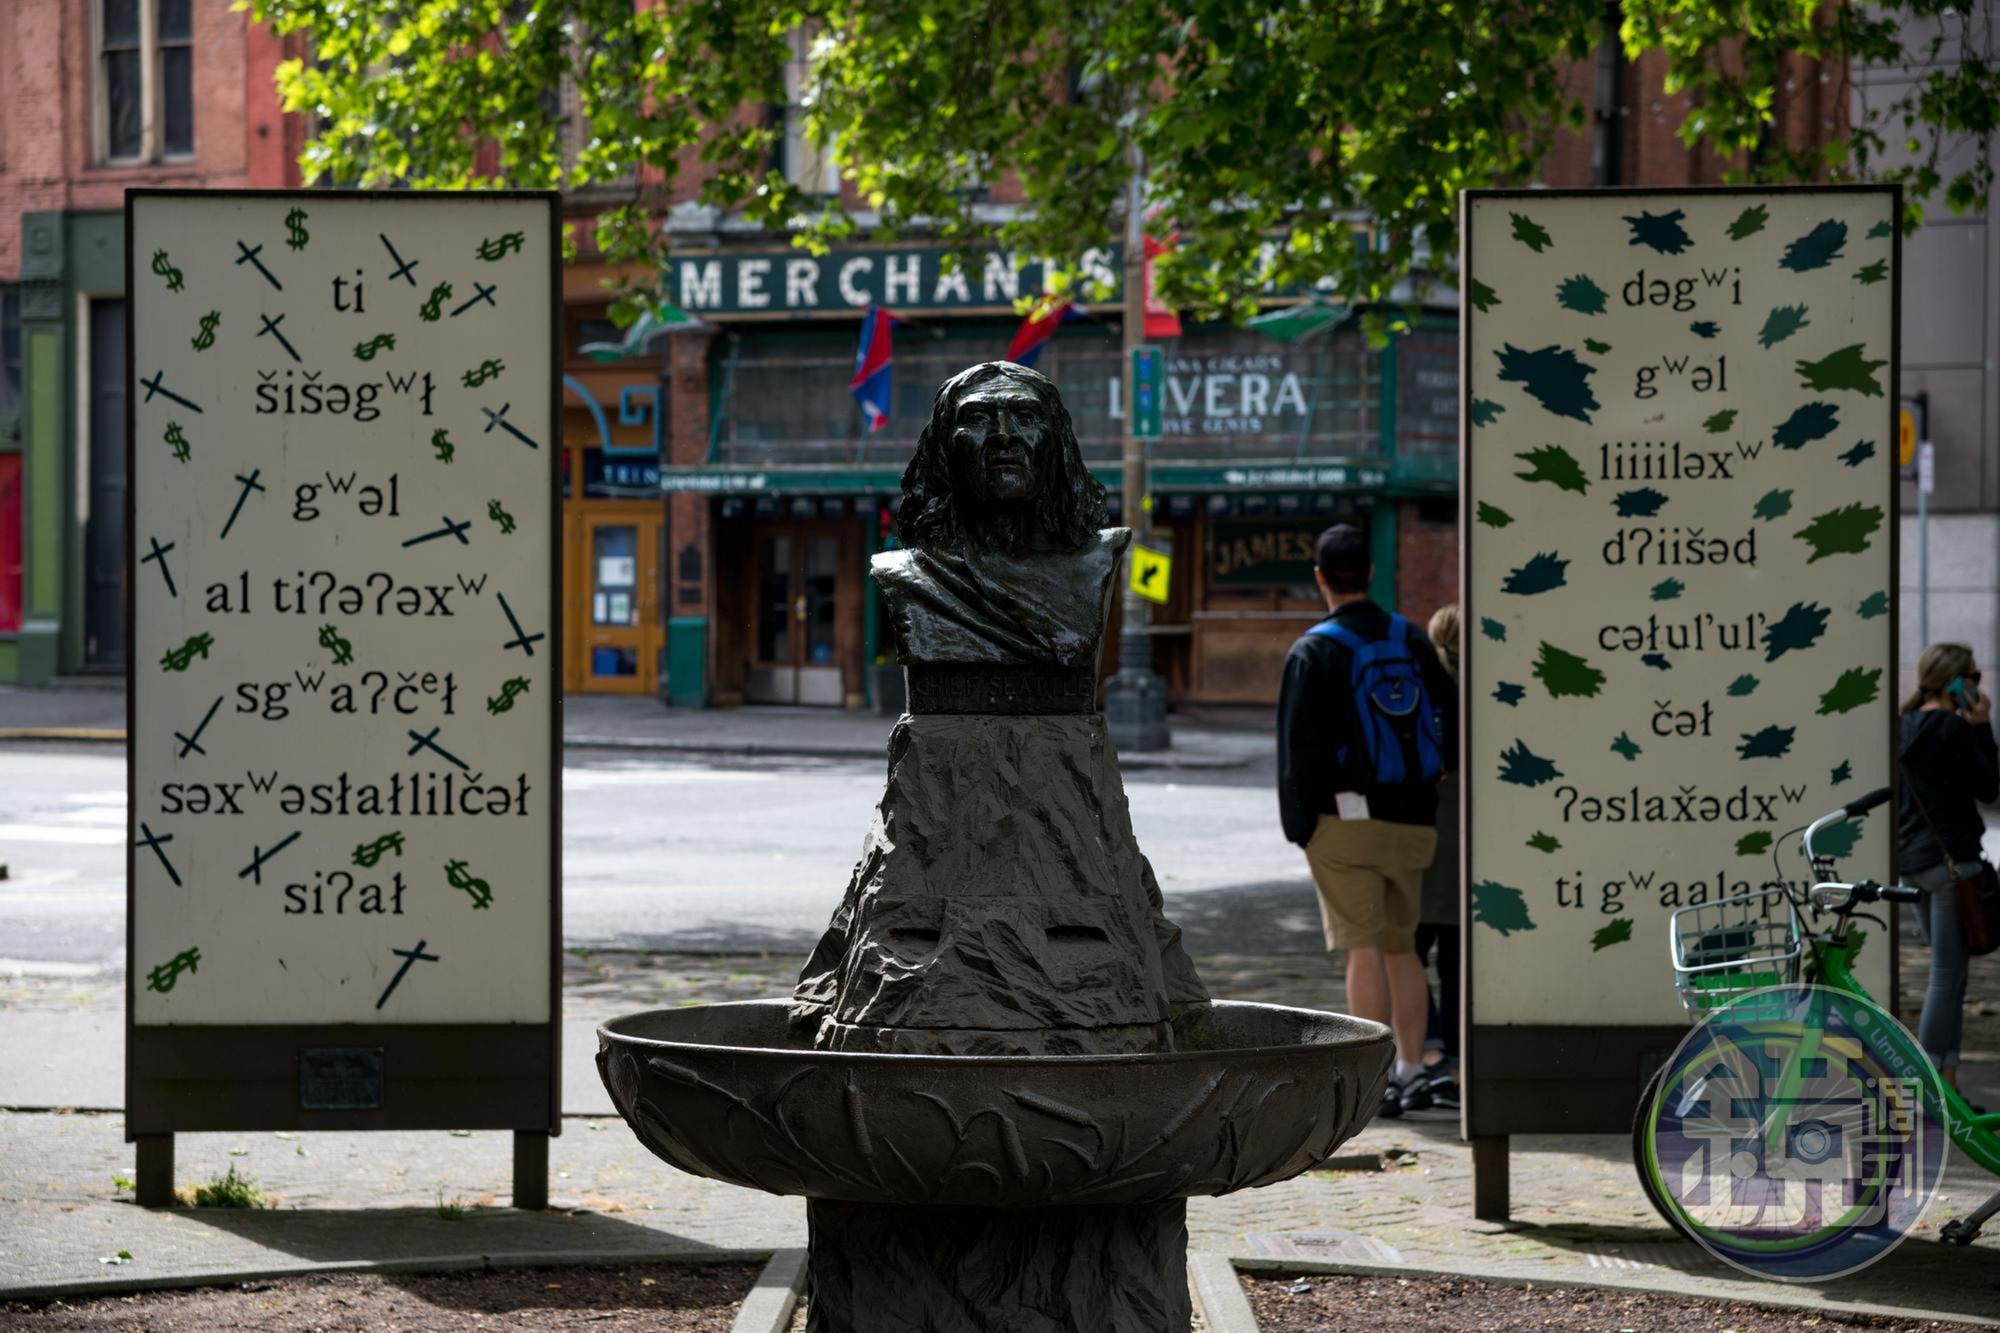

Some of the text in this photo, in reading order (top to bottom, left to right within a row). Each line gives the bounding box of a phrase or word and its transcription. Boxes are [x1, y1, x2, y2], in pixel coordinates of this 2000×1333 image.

[331, 268, 365, 313] ti
[1108, 372, 1307, 420] LVERA
[205, 570, 251, 614] al
[988, 675, 1091, 698] SEATTLE
[1555, 870, 1584, 909] ti
